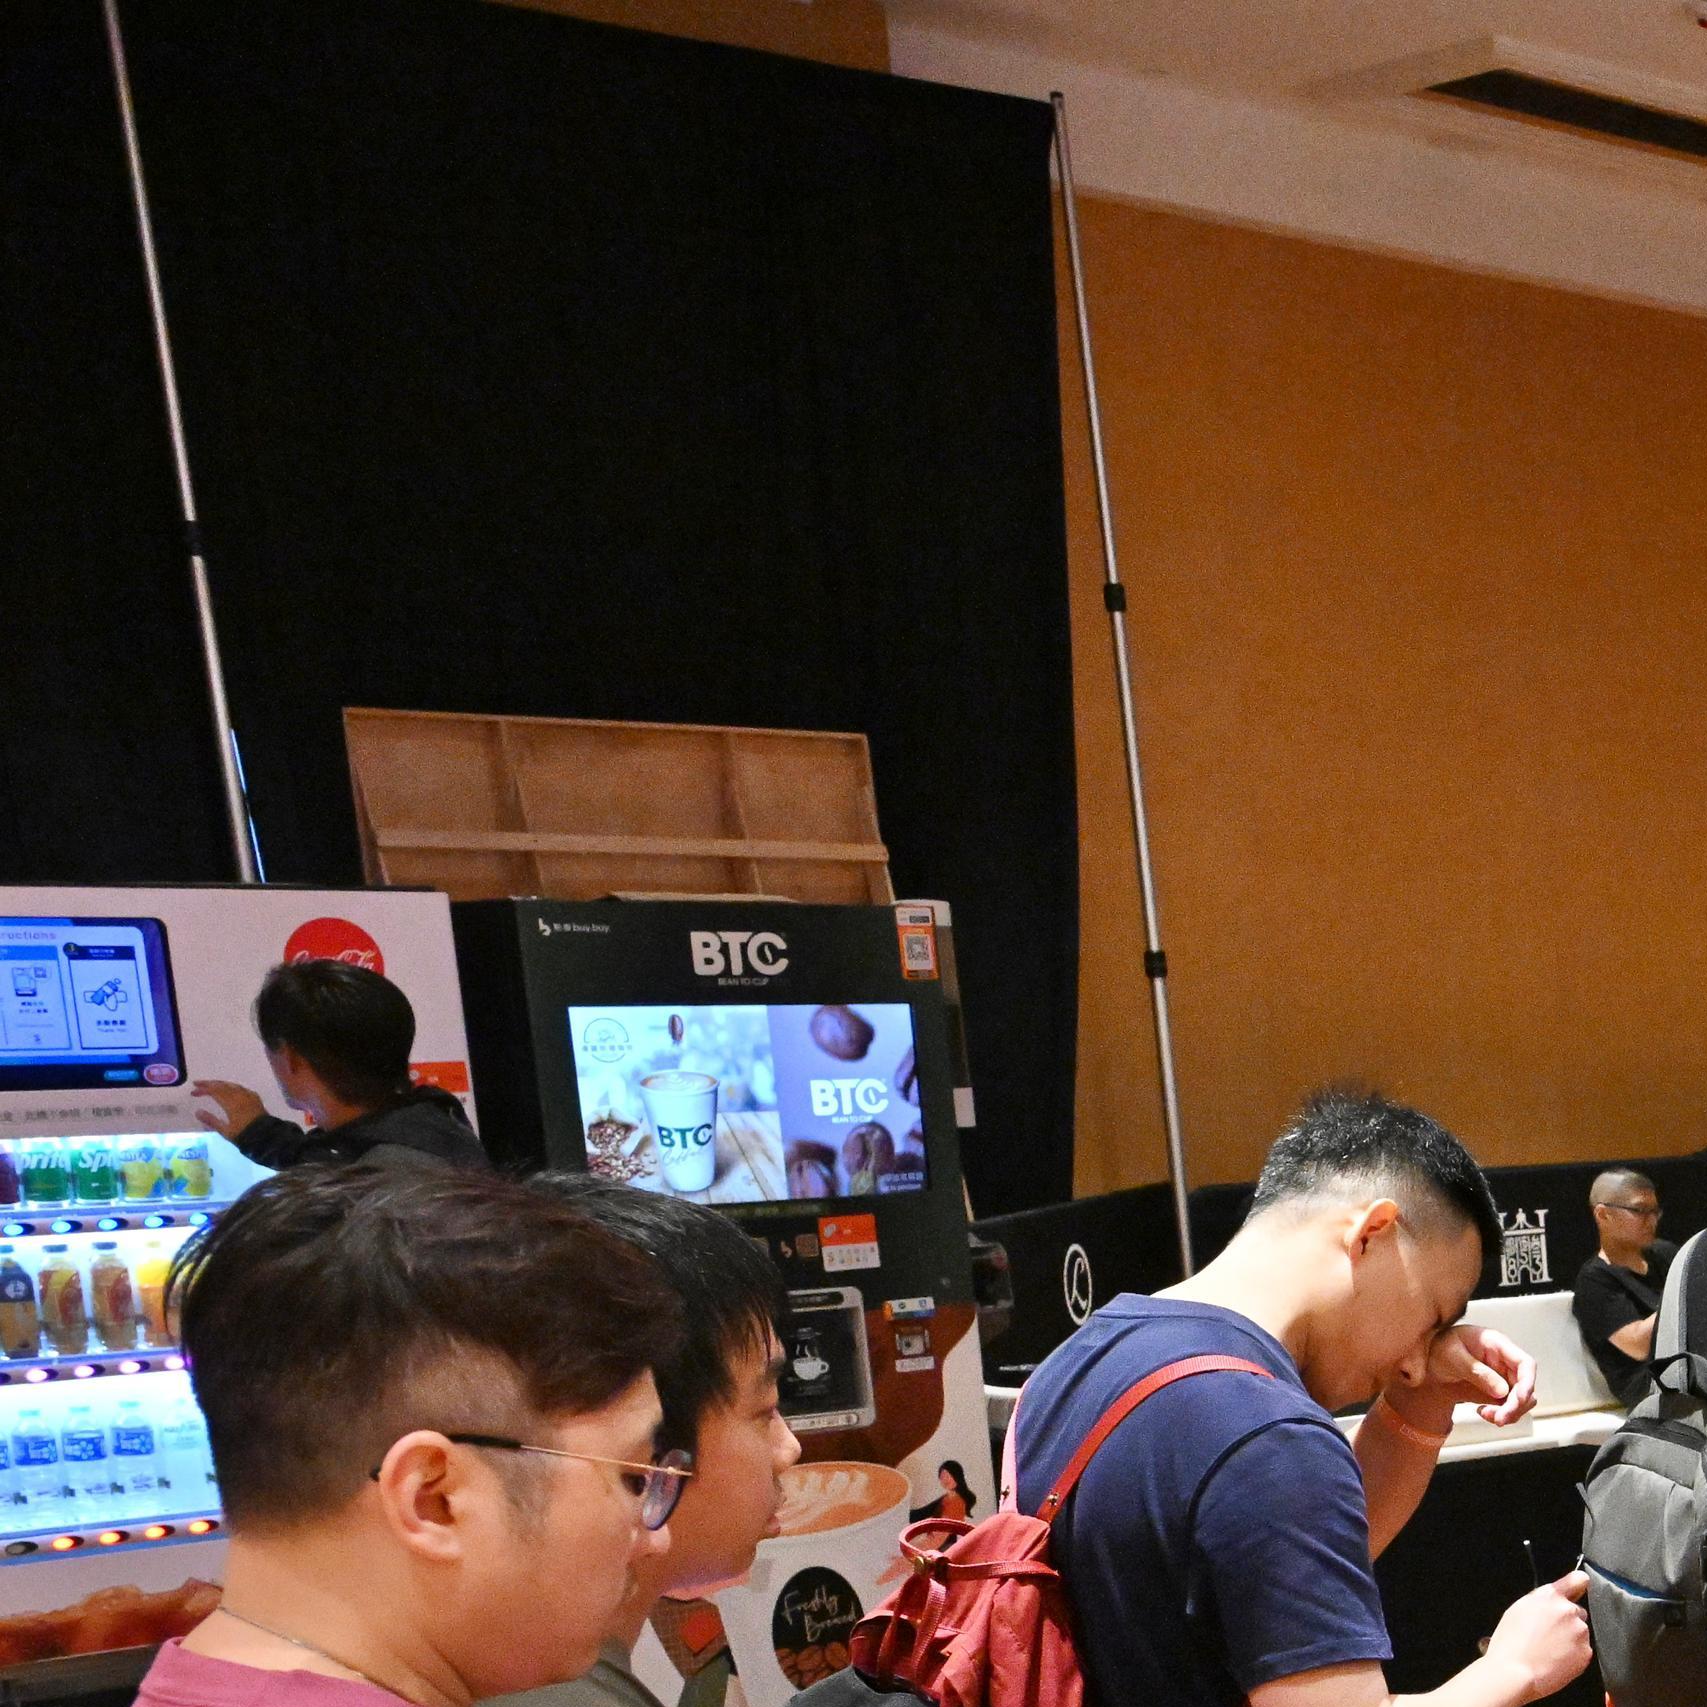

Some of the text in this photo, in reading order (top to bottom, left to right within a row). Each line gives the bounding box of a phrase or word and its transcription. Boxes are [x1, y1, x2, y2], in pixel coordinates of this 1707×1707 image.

[690, 931, 789, 977] BTC
[718, 978, 741, 986] BEAN
[810, 1078, 888, 1116] BTC
[657, 1123, 713, 1149] BTC
